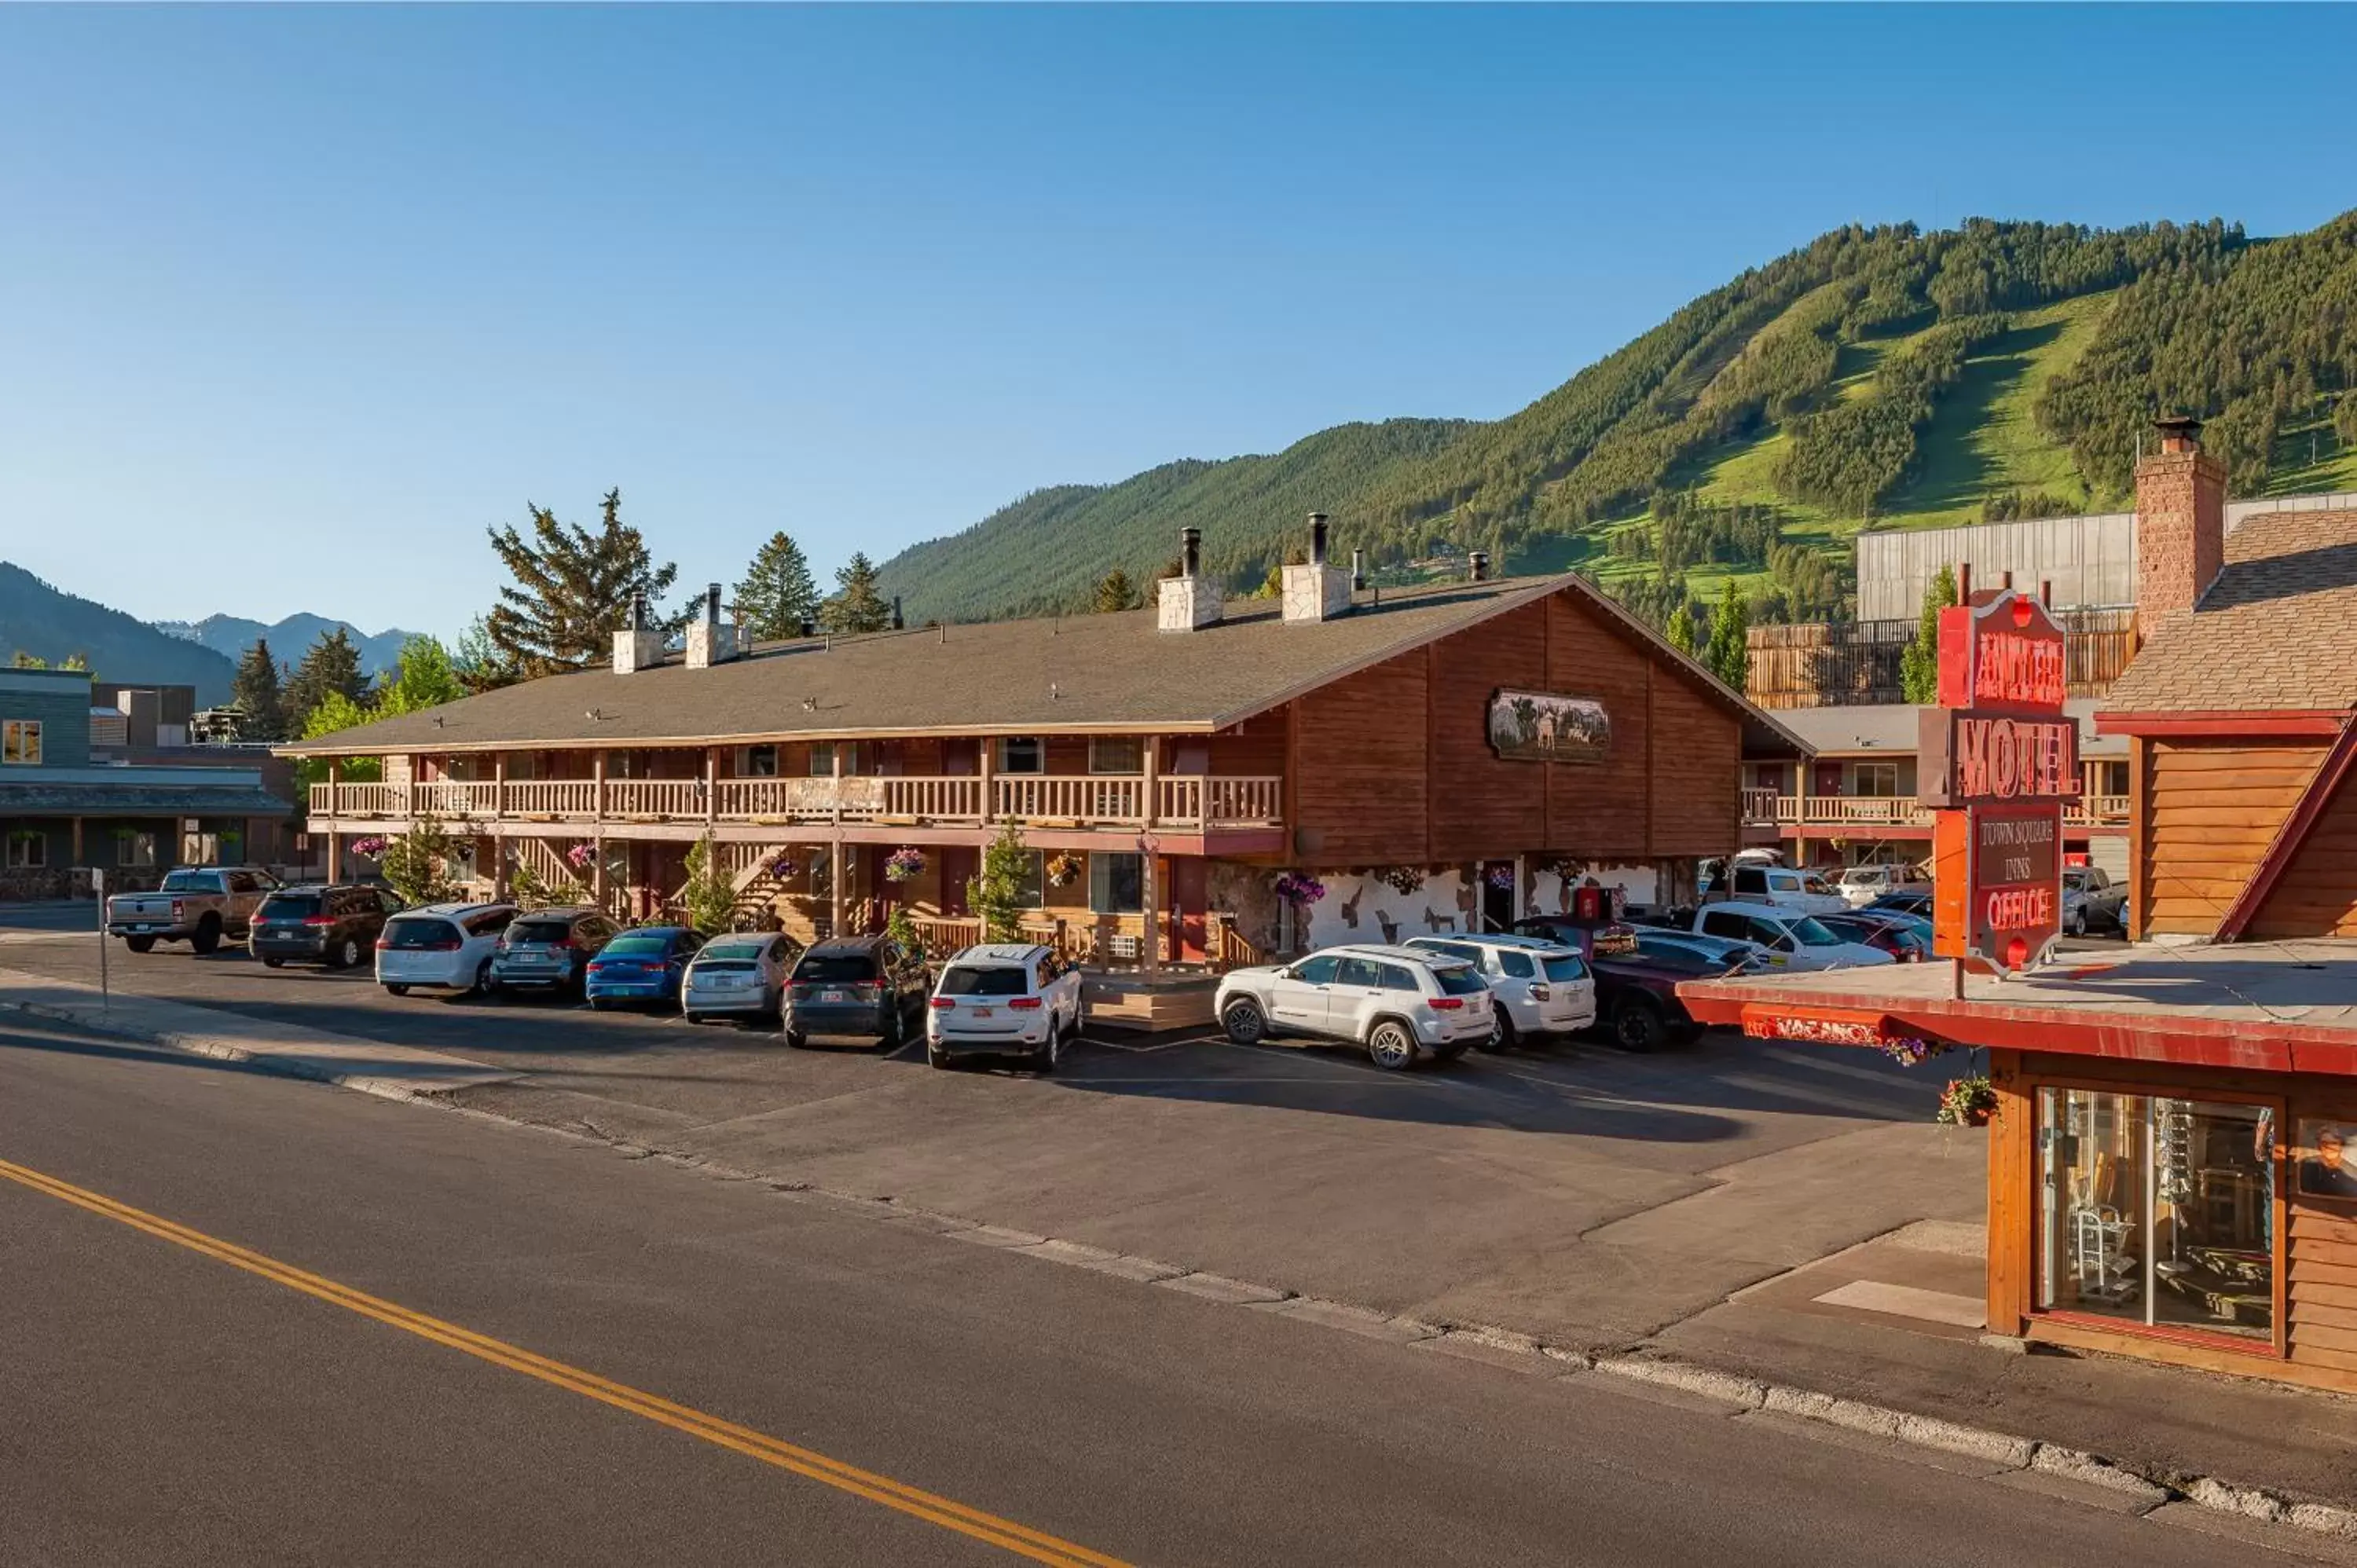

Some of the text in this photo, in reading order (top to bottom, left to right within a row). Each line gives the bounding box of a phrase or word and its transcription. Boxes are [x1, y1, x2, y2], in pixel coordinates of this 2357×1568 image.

[1957, 718, 2080, 798] MOTEL
[1981, 819, 2054, 852] TOWN SQUARE
[2004, 856, 2032, 881] INNS
[1988, 888, 2053, 931] OFFICE
[1776, 1017, 1879, 1046] VACANCY
